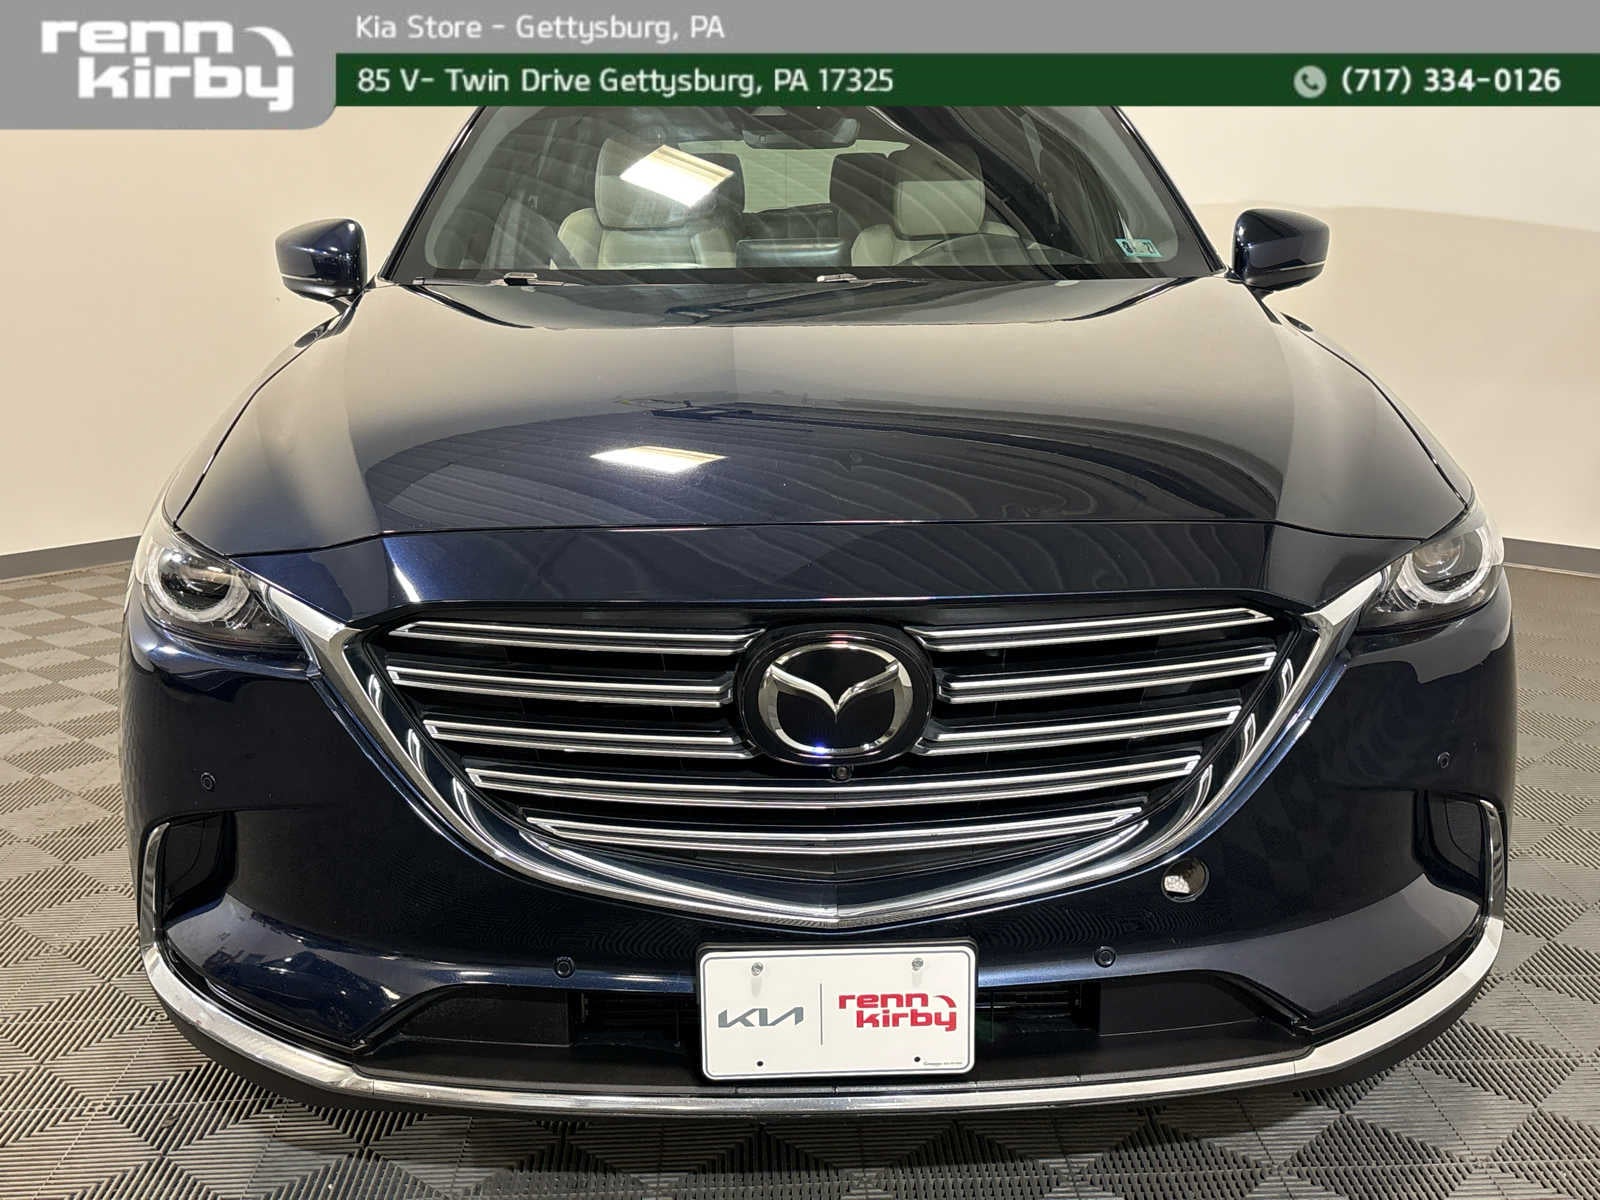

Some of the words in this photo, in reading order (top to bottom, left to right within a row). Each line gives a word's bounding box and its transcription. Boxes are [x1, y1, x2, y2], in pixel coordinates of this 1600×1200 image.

[838, 992, 929, 1010] renn
[717, 1006, 804, 1029] KIA
[856, 1009, 957, 1032] kirby
